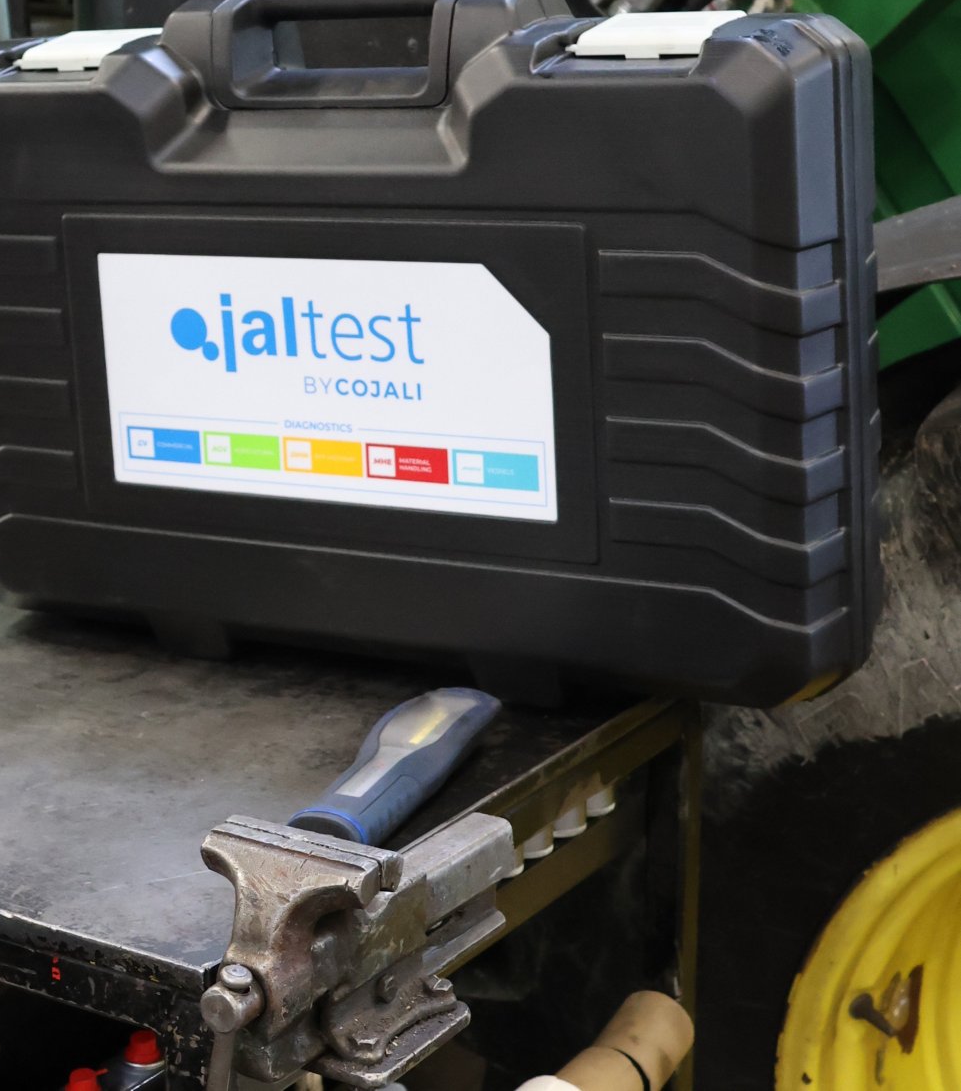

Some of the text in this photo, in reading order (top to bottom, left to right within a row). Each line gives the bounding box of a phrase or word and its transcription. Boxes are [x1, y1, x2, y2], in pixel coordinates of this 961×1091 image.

[220, 293, 425, 372] jaltest
[284, 419, 352, 433] DIAGNOSTICS
[398, 457, 431, 466] MATERIAL
[399, 465, 432, 474] HANDLING
